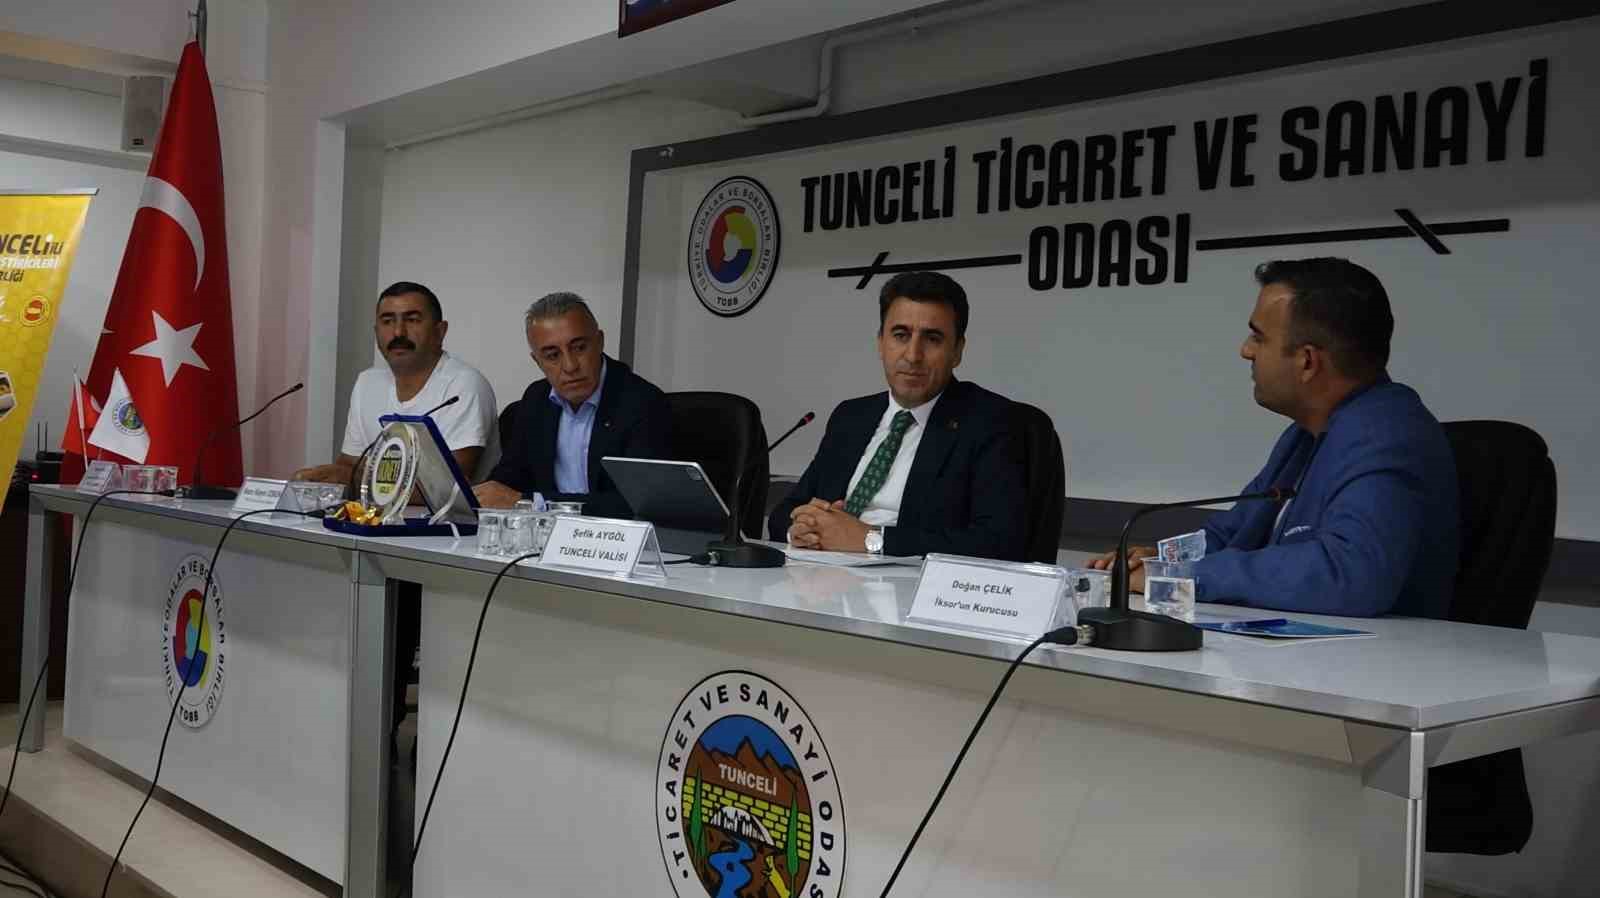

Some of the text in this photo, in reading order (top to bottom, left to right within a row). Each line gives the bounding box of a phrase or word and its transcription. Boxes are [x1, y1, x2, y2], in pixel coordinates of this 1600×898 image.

[800, 58, 1550, 233] TUNCELİ TİCARET VE SANAYİ
[1027, 213, 1191, 291] ODASI
[572, 528, 593, 540] Şefik
[559, 546, 628, 562] TUNCELİ VALİSİ
[952, 580, 1013, 596] Doğan ÇELİK
[973, 602, 1018, 617] Kurucusu
[665, 710, 696, 866] TİCARET
[700, 684, 729, 711] VE
[739, 683, 829, 783] SANAYİ
[718, 763, 778, 797] TUNCELİ
